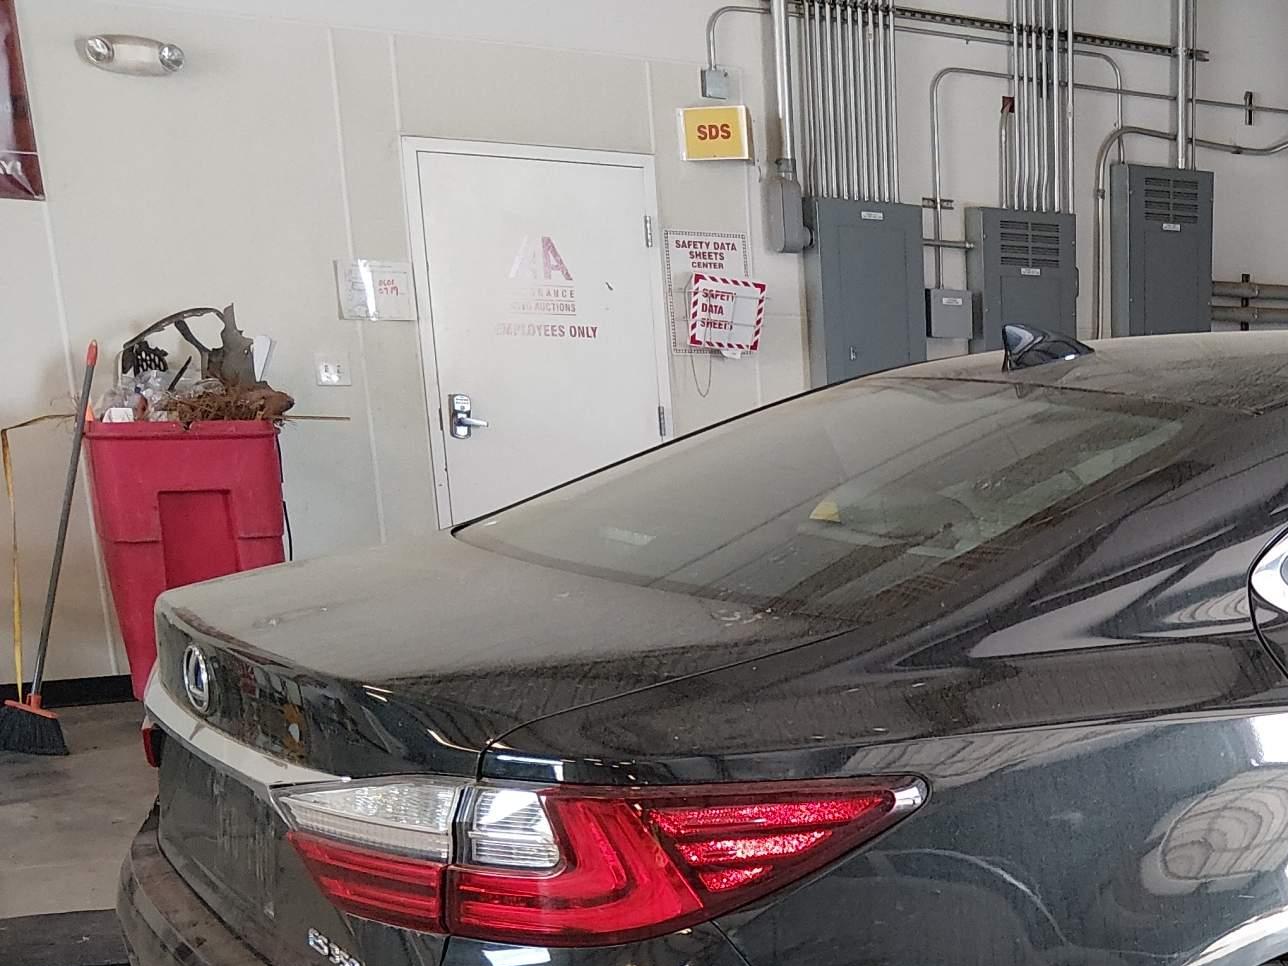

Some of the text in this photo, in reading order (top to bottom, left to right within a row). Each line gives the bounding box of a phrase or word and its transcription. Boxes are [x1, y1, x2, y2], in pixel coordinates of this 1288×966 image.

[696, 123, 731, 141] SDS
[675, 240, 737, 251] SAFETY DATA
[689, 251, 725, 261] SHEETS
[691, 261, 724, 270] CENTER
[701, 302, 724, 315] DATA
[569, 325, 598, 339] ONLY
